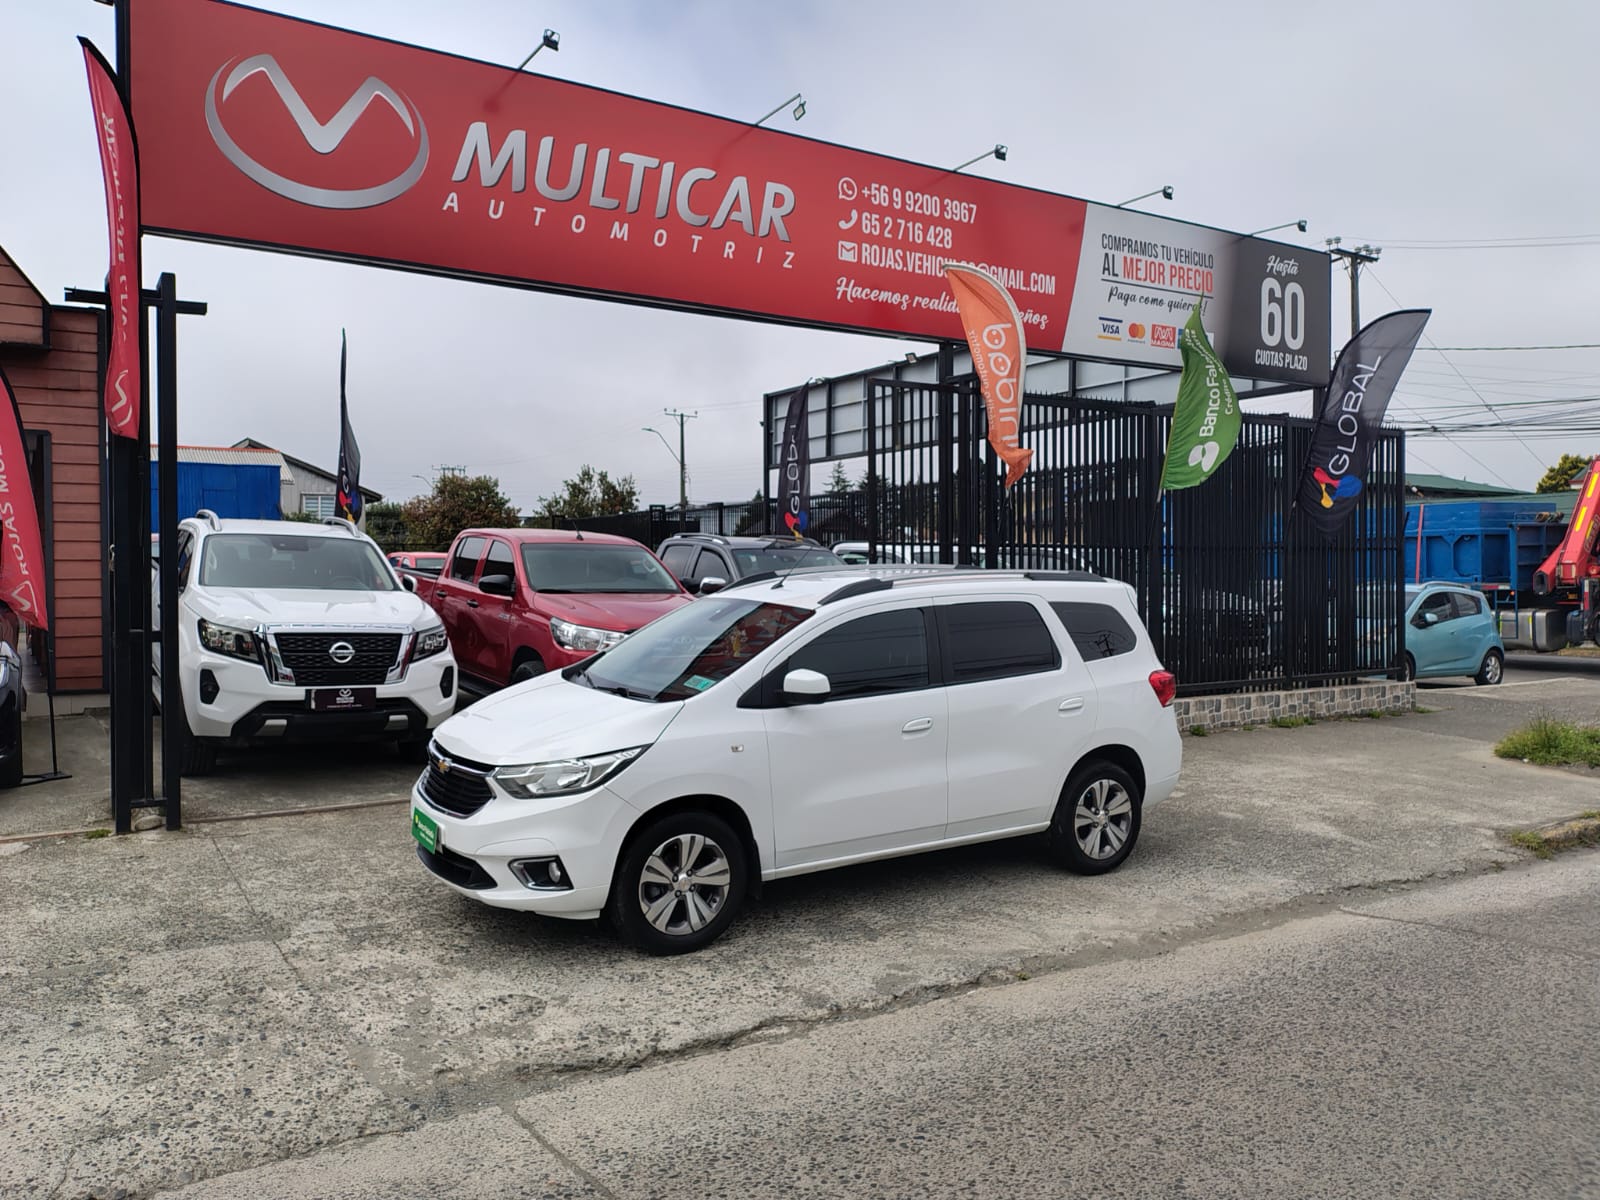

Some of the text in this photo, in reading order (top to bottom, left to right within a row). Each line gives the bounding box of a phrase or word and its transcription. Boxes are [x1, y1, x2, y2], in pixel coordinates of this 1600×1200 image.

[451, 121, 796, 242] MULTICAR
[862, 183, 977, 224] +56 9 9200 3967
[442, 192, 795, 270] AUTOMOTRIZ
[862, 212, 953, 249] 65 2 716 428
[1101, 233, 1214, 269] COMPRAMOS TU VEHÍCULO
[1266, 255, 1299, 277] Hasta
[1102, 252, 1214, 293] AL MEJOR PRECIO
[836, 276, 911, 311] Hacemos
[1108, 286, 1137, 307] Paga
[1138, 295, 1166, 307] como
[1102, 323, 1120, 335] VISA
[1261, 277, 1305, 351] 60
[1255, 349, 1308, 371] CUOTAS PLAZO
[1327, 354, 1382, 476] GLOBAL
[1, 502, 29, 575] ROJAS
